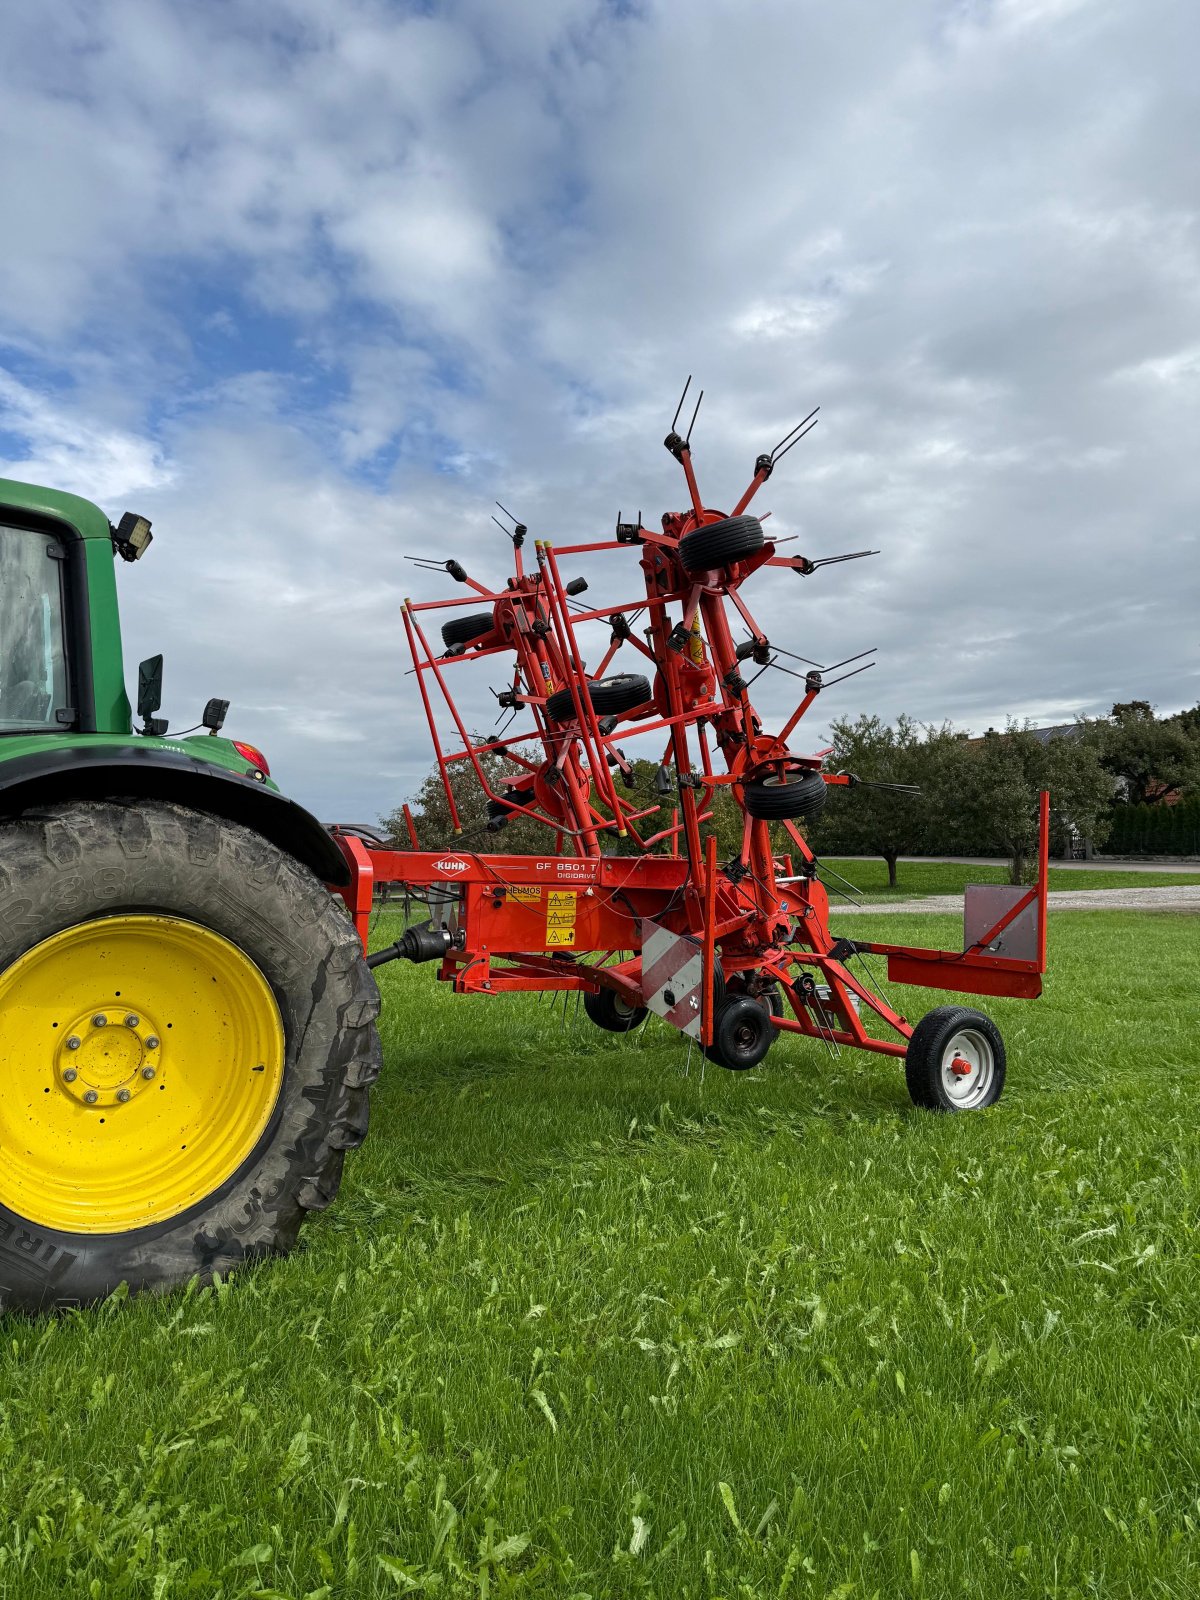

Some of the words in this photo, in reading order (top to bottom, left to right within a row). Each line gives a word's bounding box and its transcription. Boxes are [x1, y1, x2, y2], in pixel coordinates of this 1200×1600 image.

[437, 860, 466, 871] KUHN
[536, 862, 552, 870] GF
[557, 863, 586, 871] 8501
[590, 864, 597, 872] T
[557, 872, 597, 880] DIGIDRIVE
